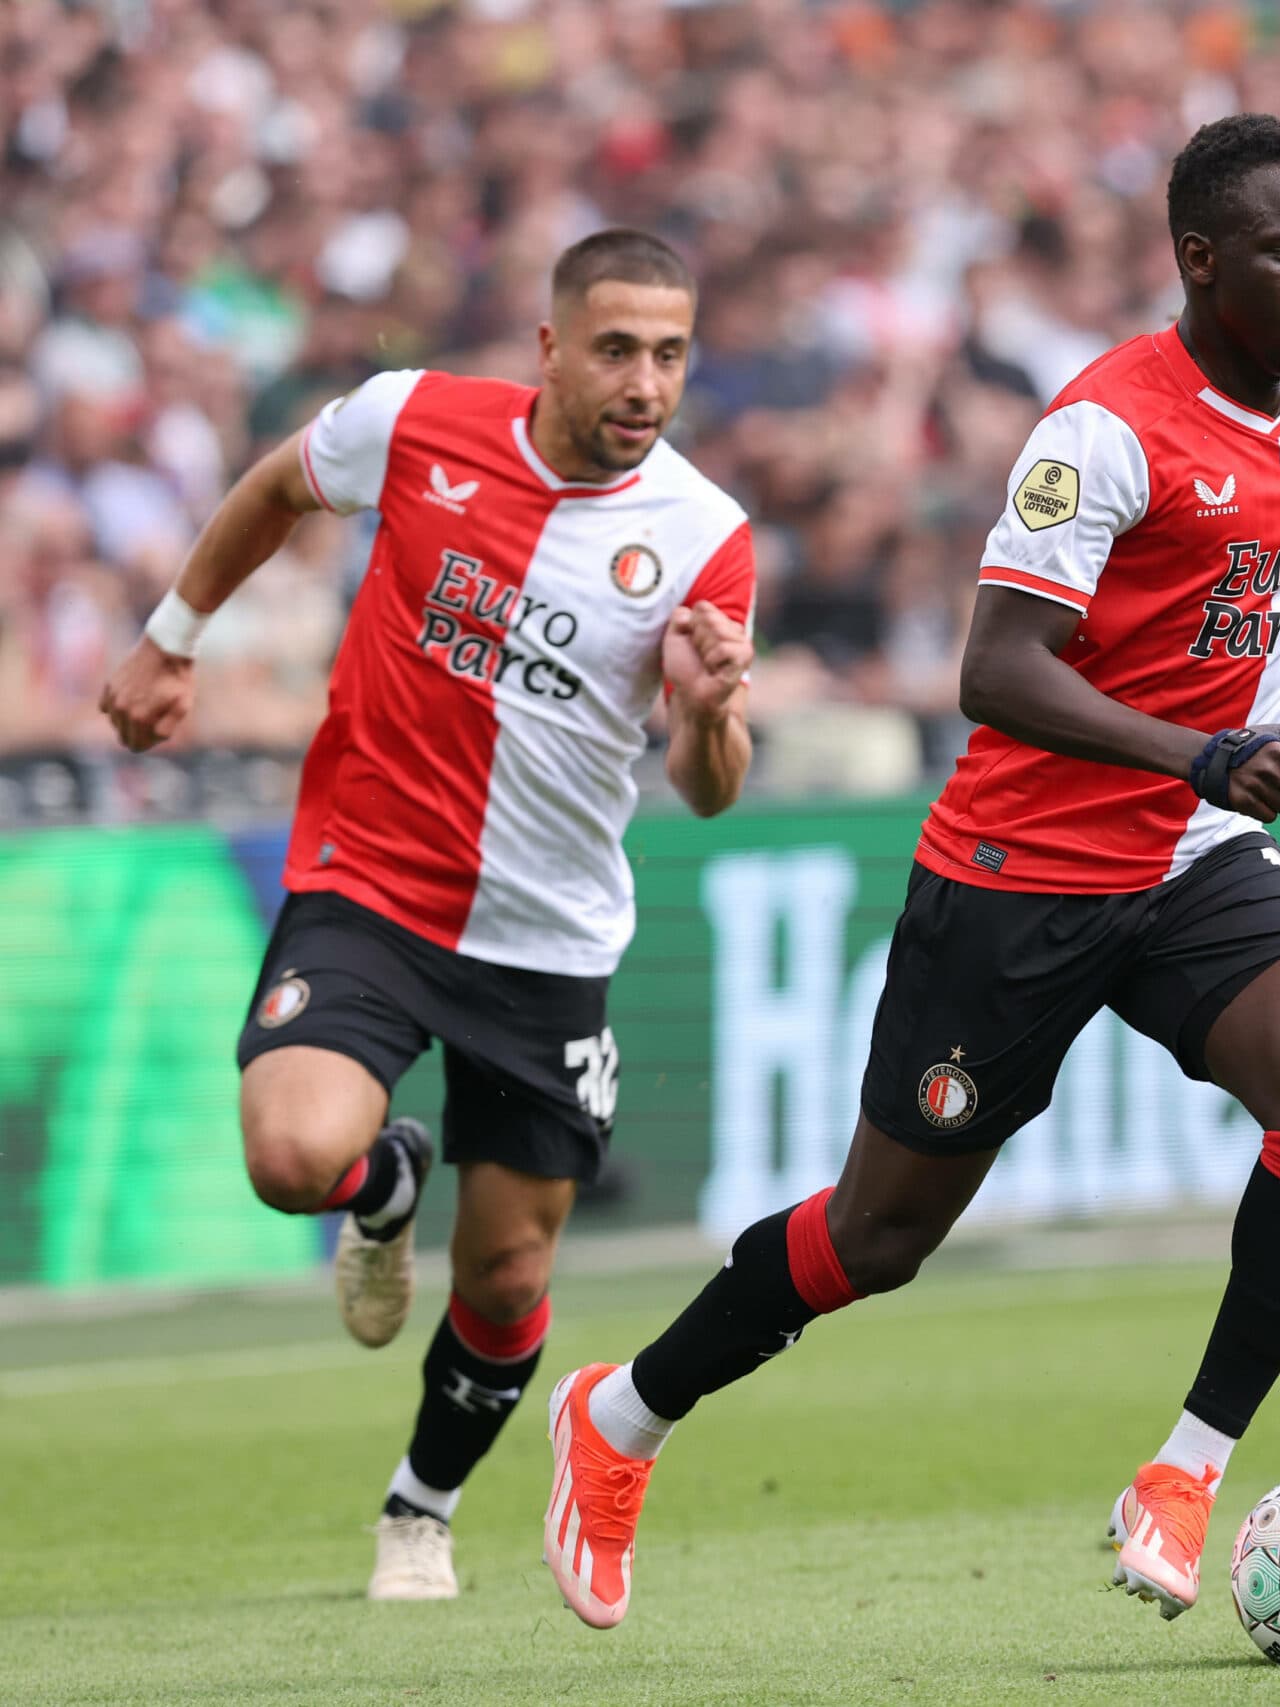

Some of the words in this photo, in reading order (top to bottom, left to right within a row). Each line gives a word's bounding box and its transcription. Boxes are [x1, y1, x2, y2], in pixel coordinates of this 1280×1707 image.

[1023, 490, 1068, 511] VRIENDEN
[1023, 501, 1059, 518] LOTERIJ
[1196, 505, 1240, 518] CASTORE
[425, 548, 577, 648] Euro
[416, 605, 582, 701] Parcs
[926, 1067, 974, 1095] FEYENOORD
[919, 1097, 971, 1127] ROTTERDAM
